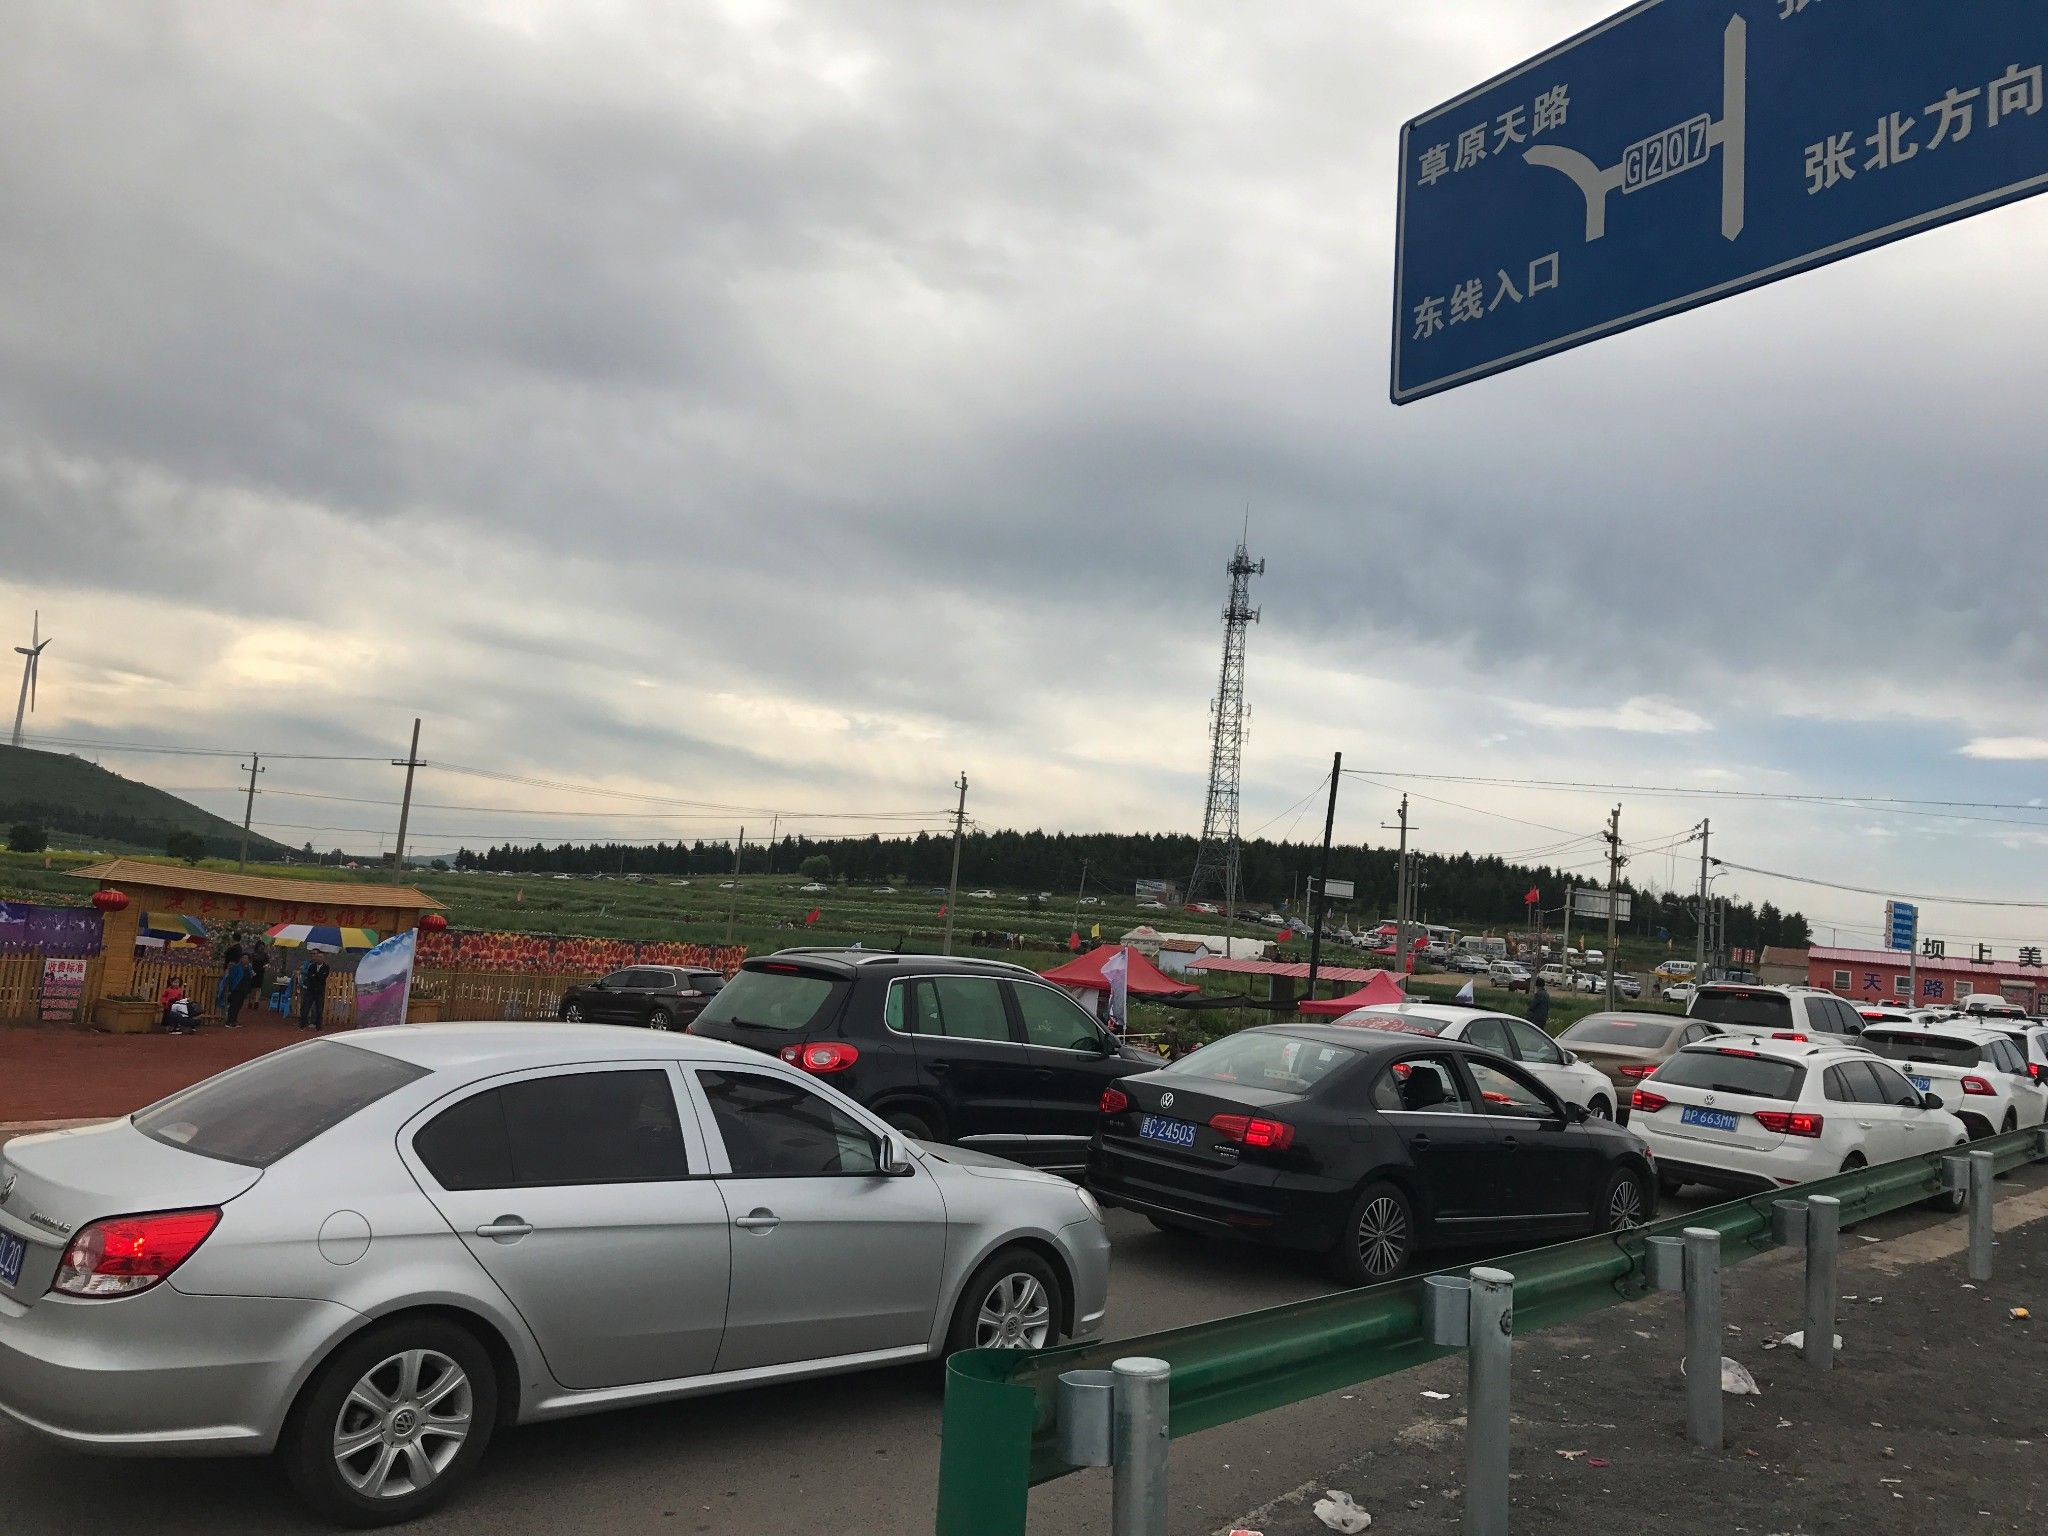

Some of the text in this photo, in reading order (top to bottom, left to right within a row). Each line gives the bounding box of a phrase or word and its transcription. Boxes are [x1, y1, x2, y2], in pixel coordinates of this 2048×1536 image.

[1417, 83, 1571, 188] 草原天路
[1624, 120, 1709, 190] G207
[1804, 63, 2045, 195] 张北方向
[1412, 252, 1560, 341] 东线入口
